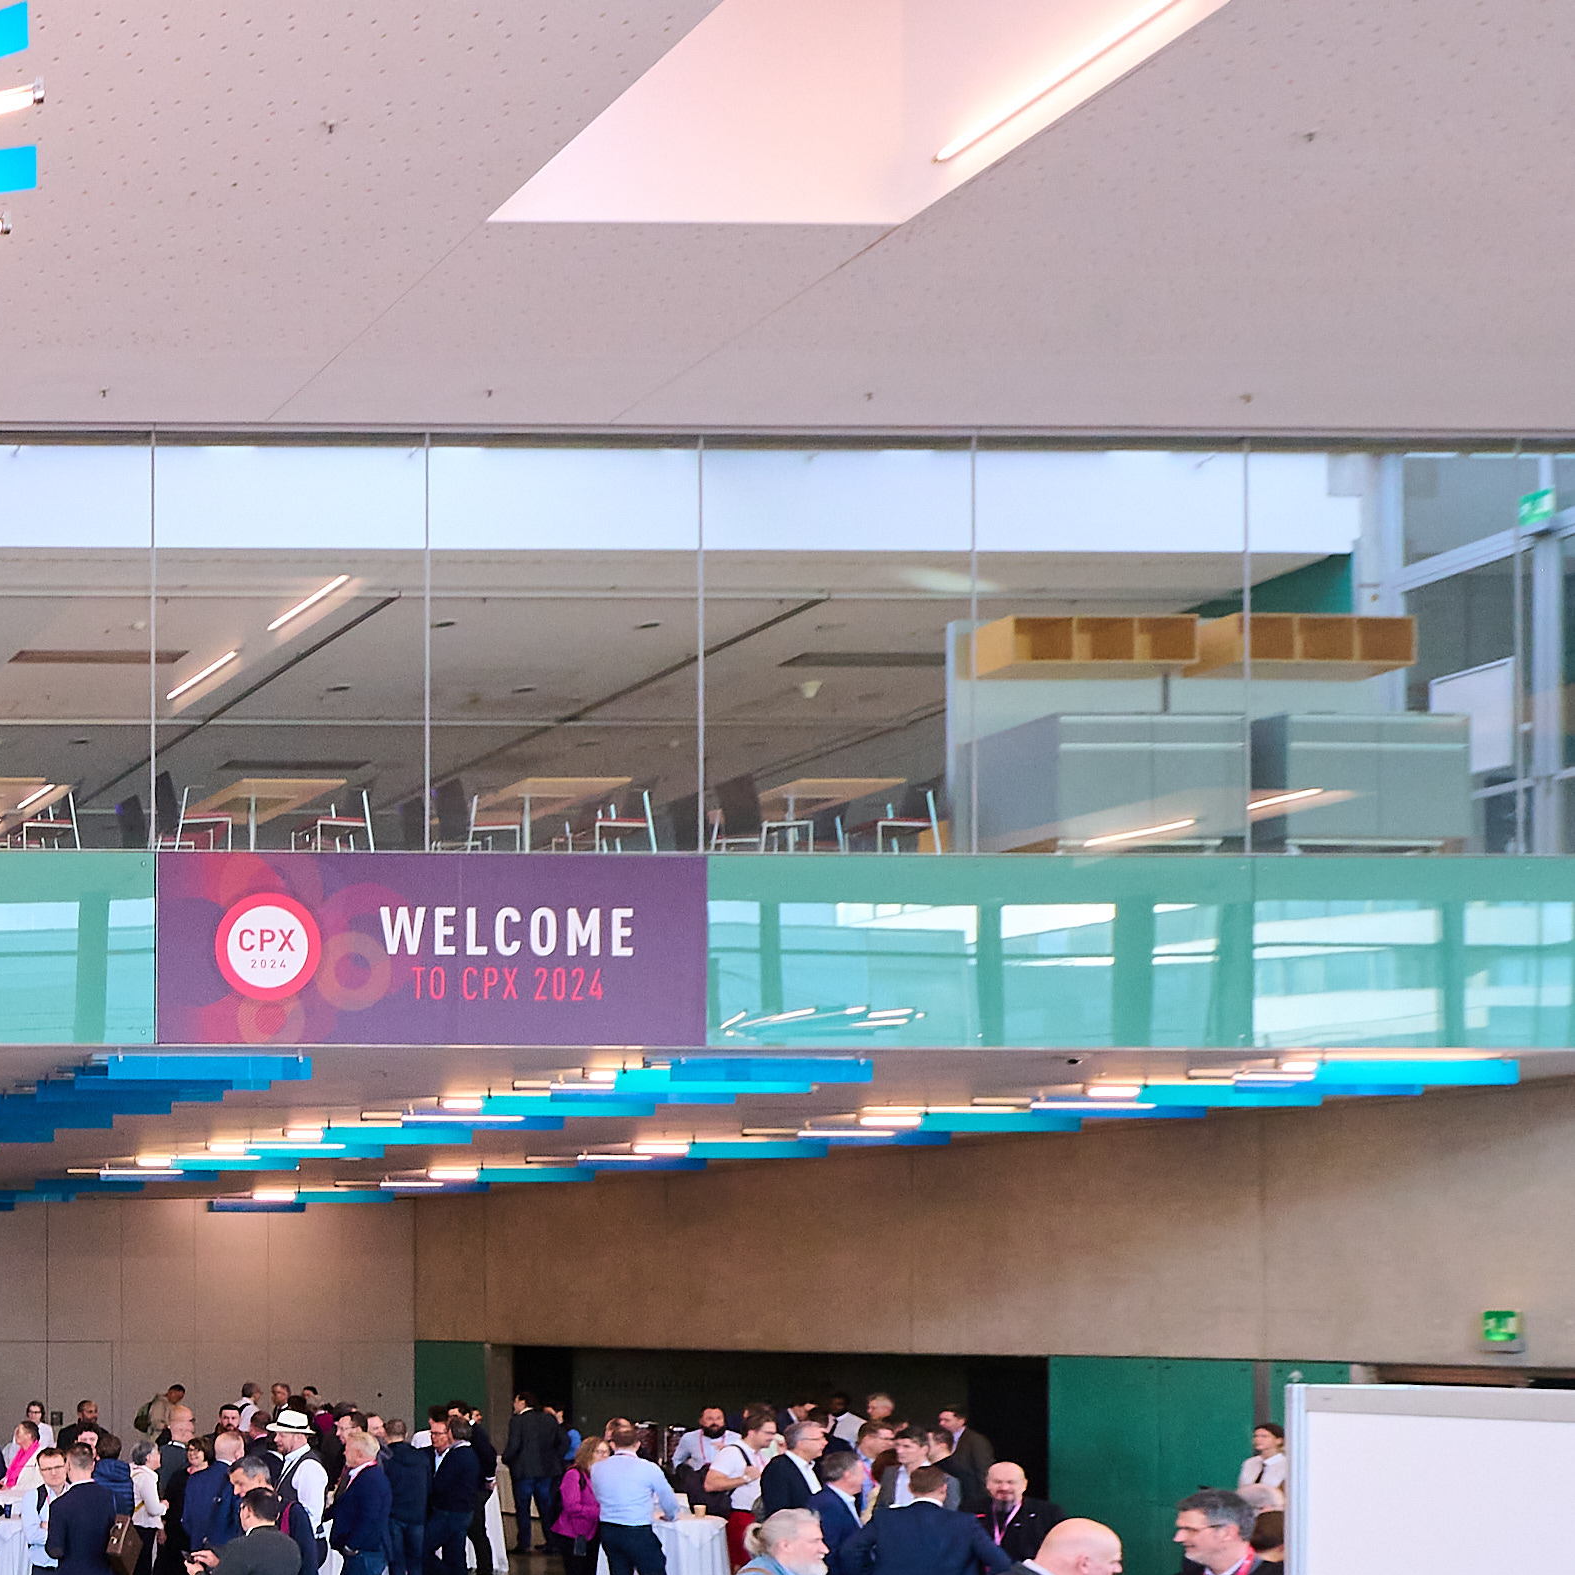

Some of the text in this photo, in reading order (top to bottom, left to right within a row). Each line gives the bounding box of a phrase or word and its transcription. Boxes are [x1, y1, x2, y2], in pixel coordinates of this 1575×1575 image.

[238, 928, 295, 952] CPX
[380, 906, 635, 957] WELCOME
[250, 959, 287, 969] 2024
[412, 966, 604, 1001] TO CPX 2024
